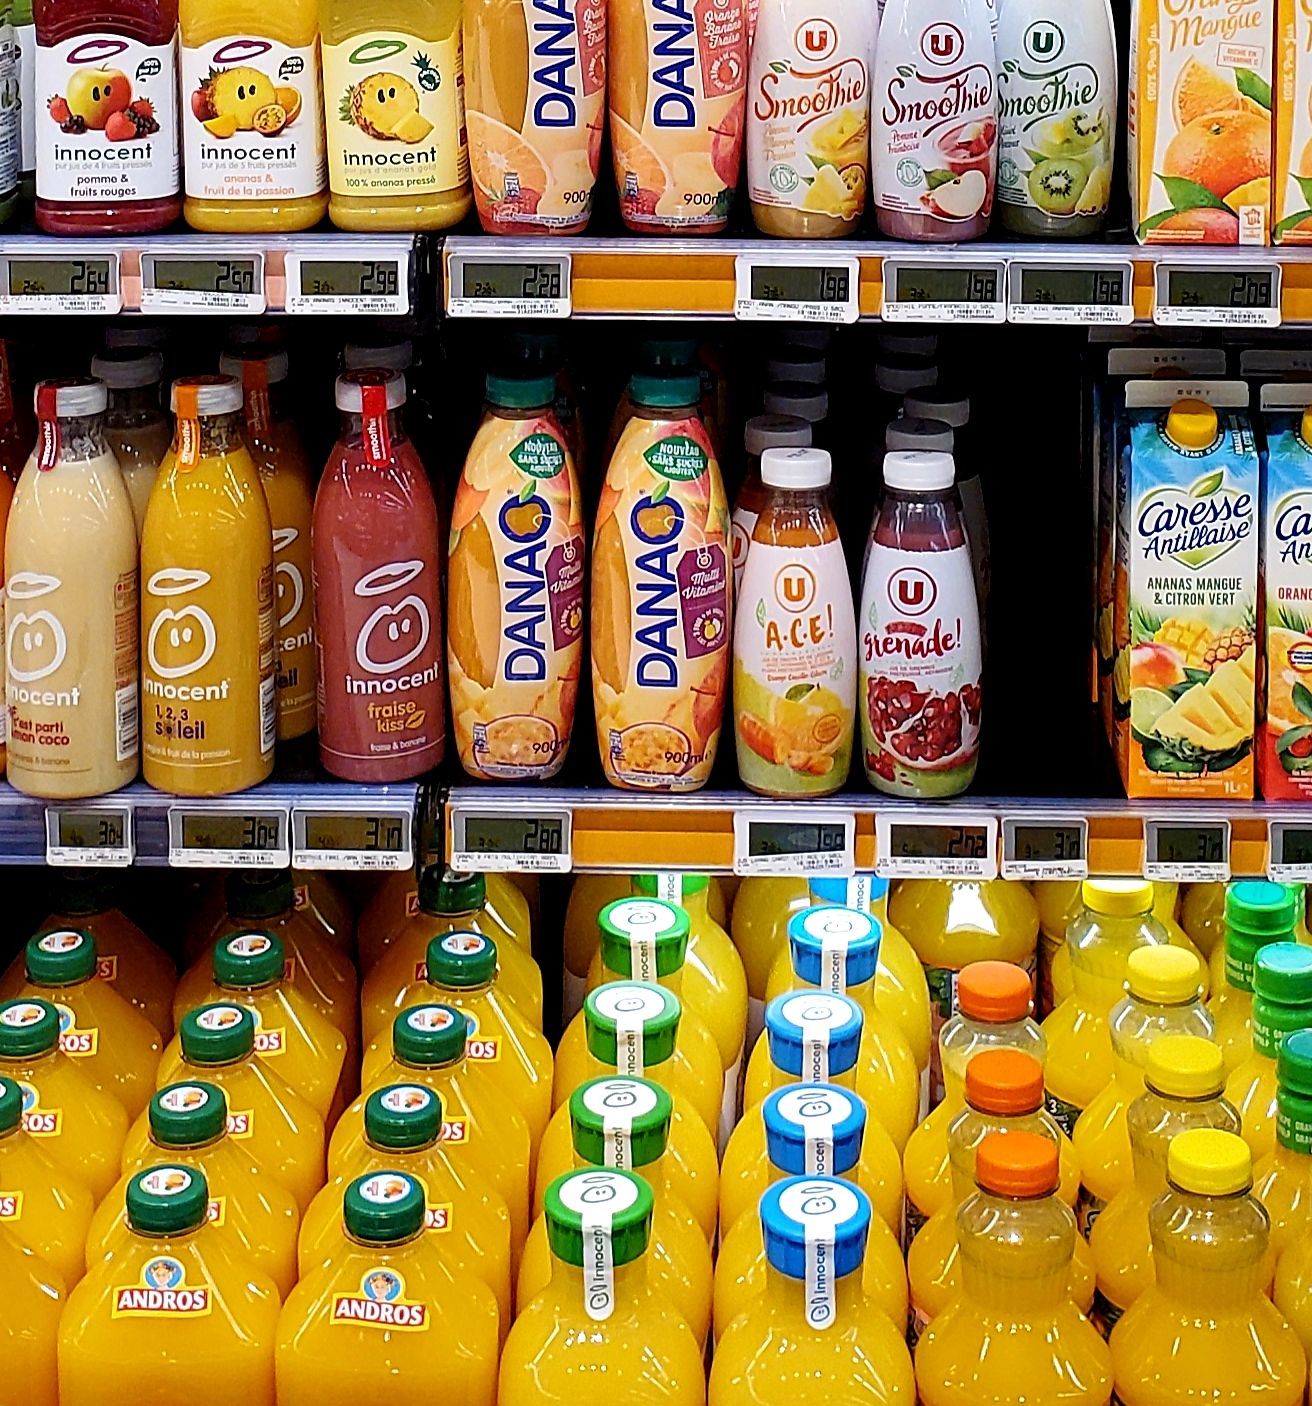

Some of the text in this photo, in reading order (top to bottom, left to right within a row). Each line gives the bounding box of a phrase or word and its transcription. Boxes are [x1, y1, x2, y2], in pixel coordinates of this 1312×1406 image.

[703, 21, 742, 38] Banane
[1169, 11, 1262, 53] Mangue
[755, 60, 866, 121] Smoothie
[70, 184, 137, 198] fruits rouges
[1139, 493, 1252, 538] Caresse
[1143, 520, 1250, 561] Antillaise
[632, 494, 685, 688] DANAO
[1166, 592, 1235, 605] CITRON VERT
[865, 618, 961, 661] grenade!
[368, 700, 415, 718] fraise
[376, 716, 405, 732] kiss
[117, 1290, 206, 1311] ANDROS
